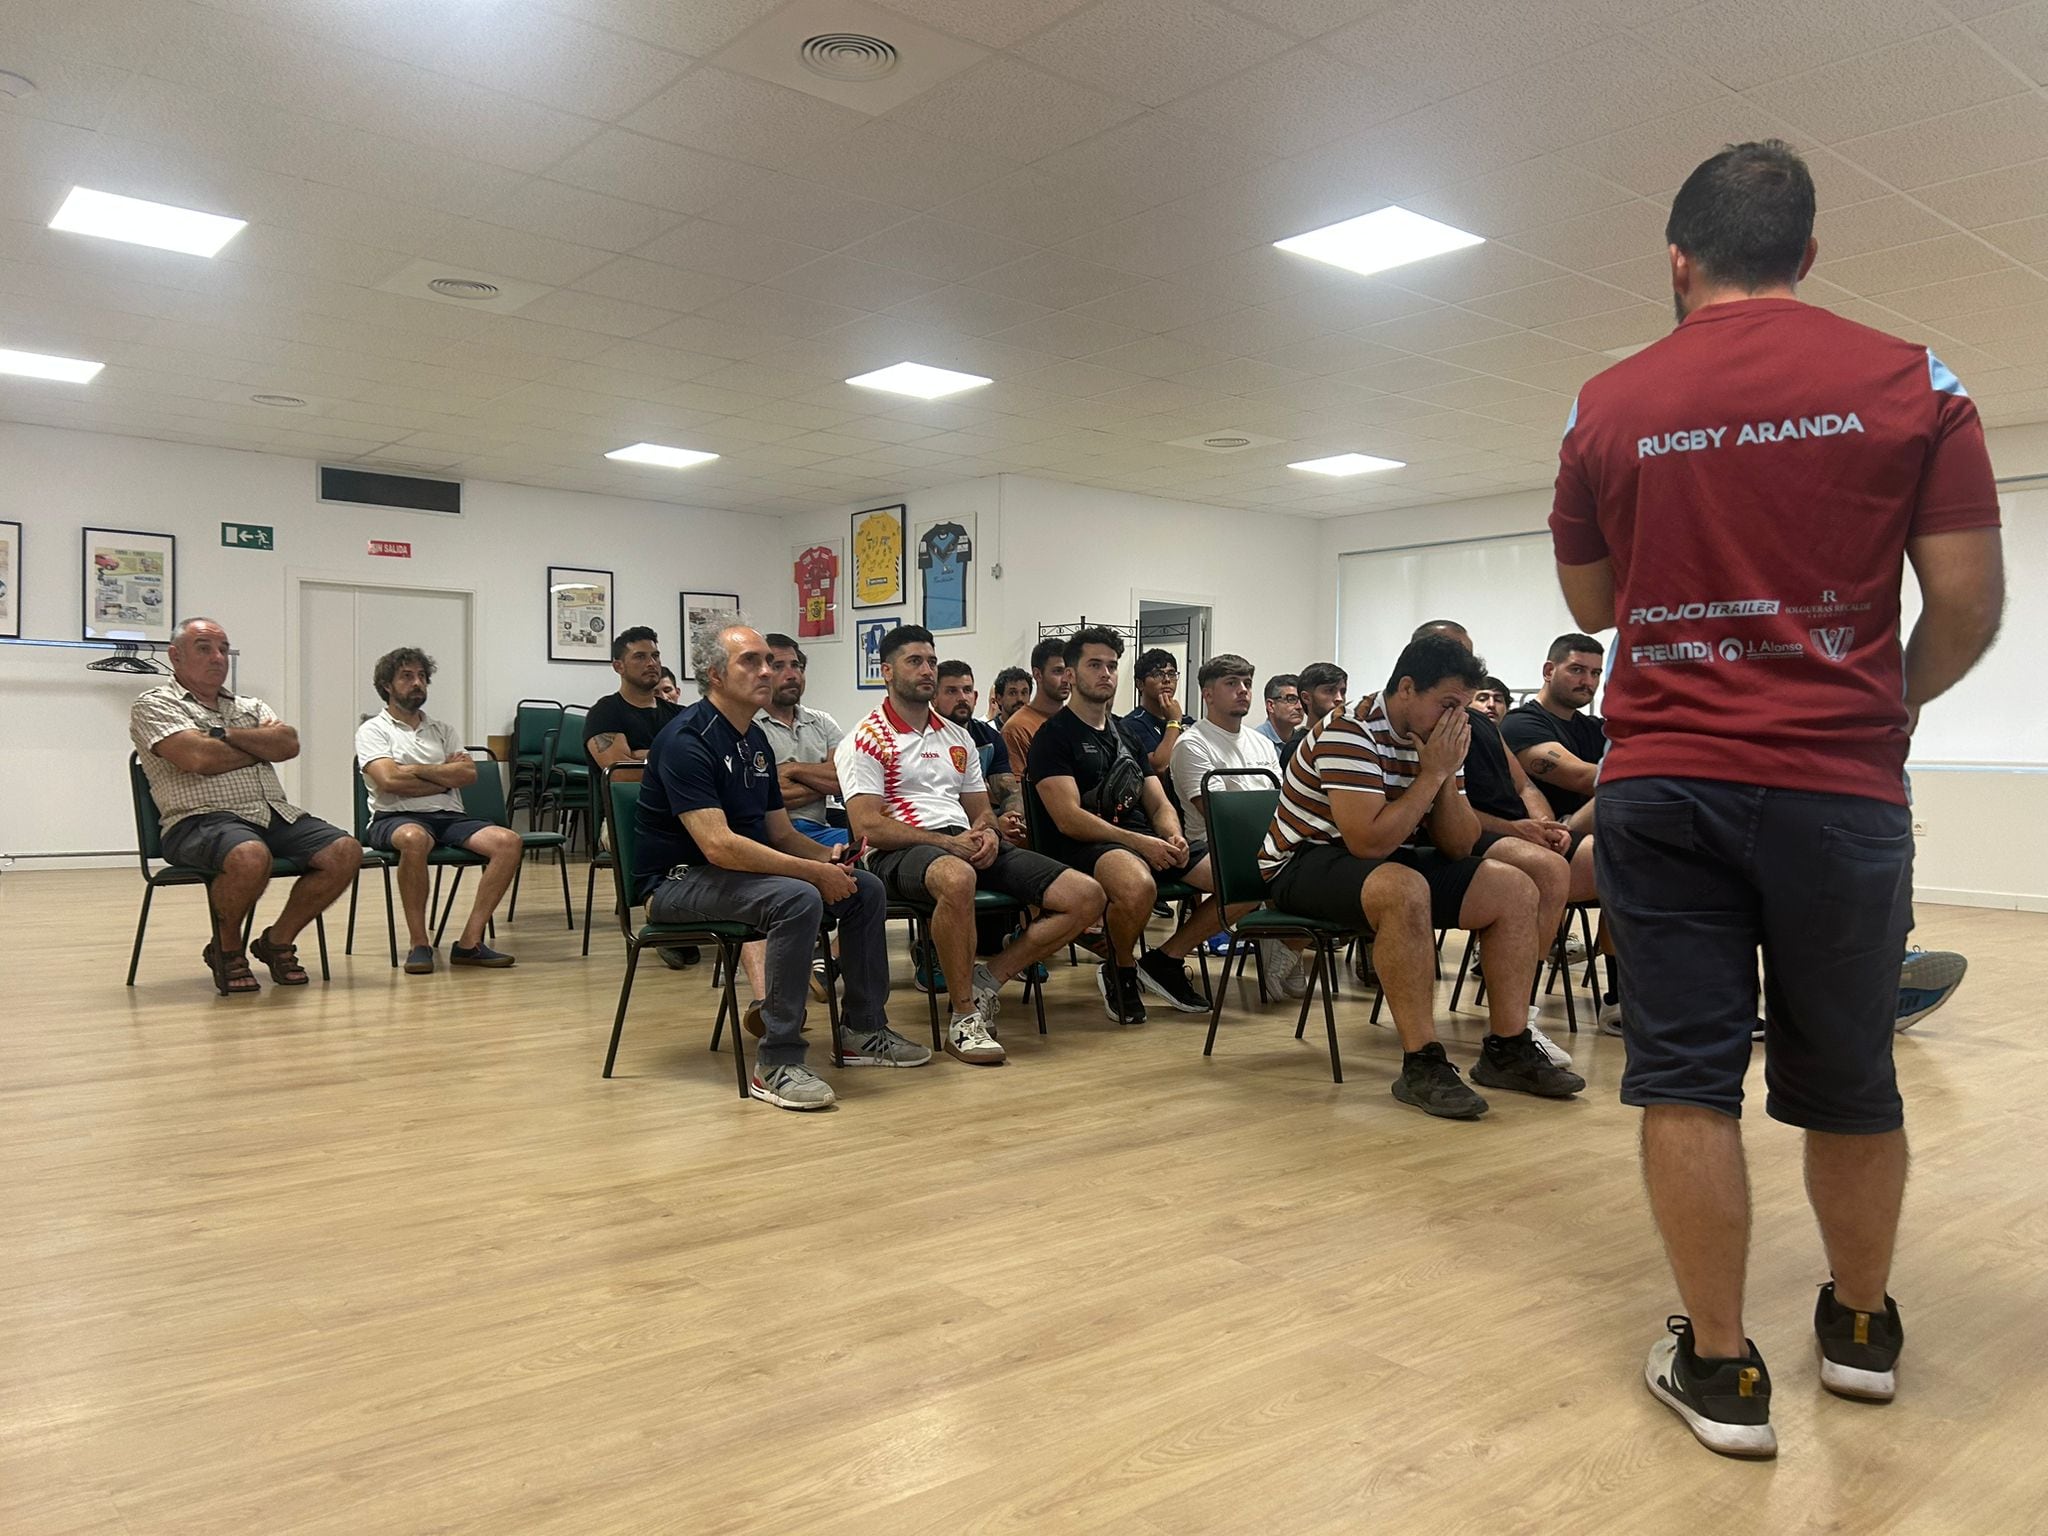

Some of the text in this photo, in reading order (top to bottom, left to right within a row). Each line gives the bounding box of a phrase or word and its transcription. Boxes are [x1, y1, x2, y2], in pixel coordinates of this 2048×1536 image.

[1637, 412, 1865, 459] RUGBY ARANDA
[383, 544, 408, 554] SALIDA
[1628, 600, 1777, 625] ROJO TRAILER
[1760, 639, 1803, 652] Alonso
